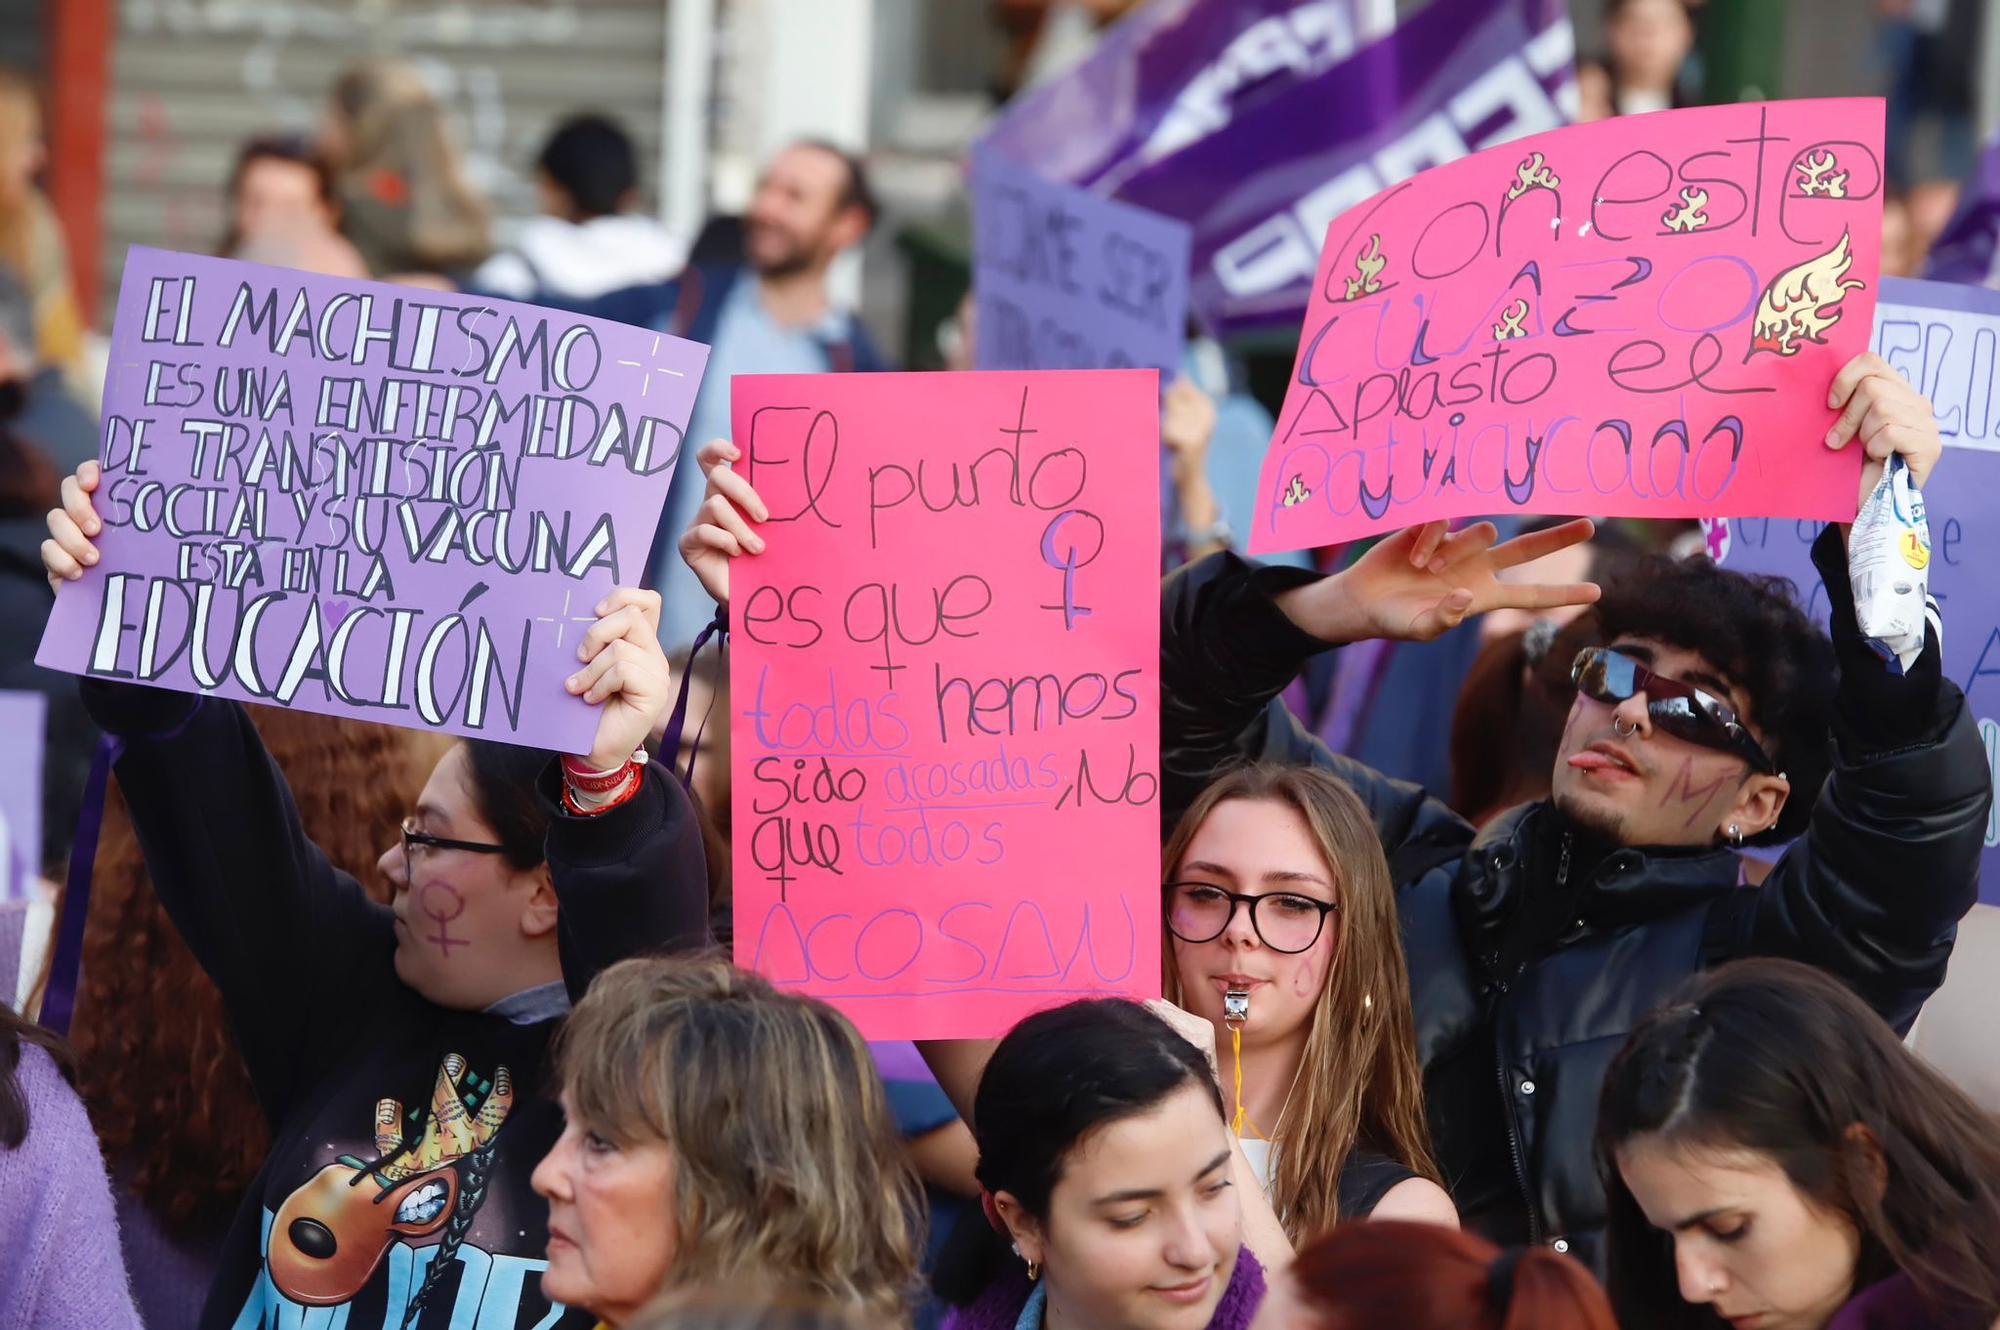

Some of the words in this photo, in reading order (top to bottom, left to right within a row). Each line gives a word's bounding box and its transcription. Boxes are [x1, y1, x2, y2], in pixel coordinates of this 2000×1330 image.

[1324, 182, 1562, 303] Con
[1590, 106, 1882, 245] este
[142, 276, 203, 346] EL
[217, 281, 602, 392] MACHISMO
[1608, 333, 1777, 393] el
[103, 415, 156, 475] DE
[181, 417, 522, 511] TRANSMISIÓN
[144, 360, 205, 407] ES
[213, 366, 294, 426] UNA
[315, 376, 684, 476] ENFERMEDAD
[749, 406, 842, 528] El
[868, 386, 1086, 549] punto
[103, 477, 287, 542] SOCIAL
[292, 489, 318, 544] Y
[315, 496, 389, 554] SU
[396, 499, 620, 585] VACUNA
[281, 547, 324, 593] EN
[333, 549, 395, 602] LA
[87, 572, 531, 731] EDUCACIÓN
[744, 585, 823, 648] es
[843, 575, 992, 690] que
[742, 664, 910, 752] todas
[935, 662, 1142, 743] hemos
[751, 816, 844, 903] que
[848, 803, 1005, 867] todos
[752, 893, 1135, 985] ACOSAN
